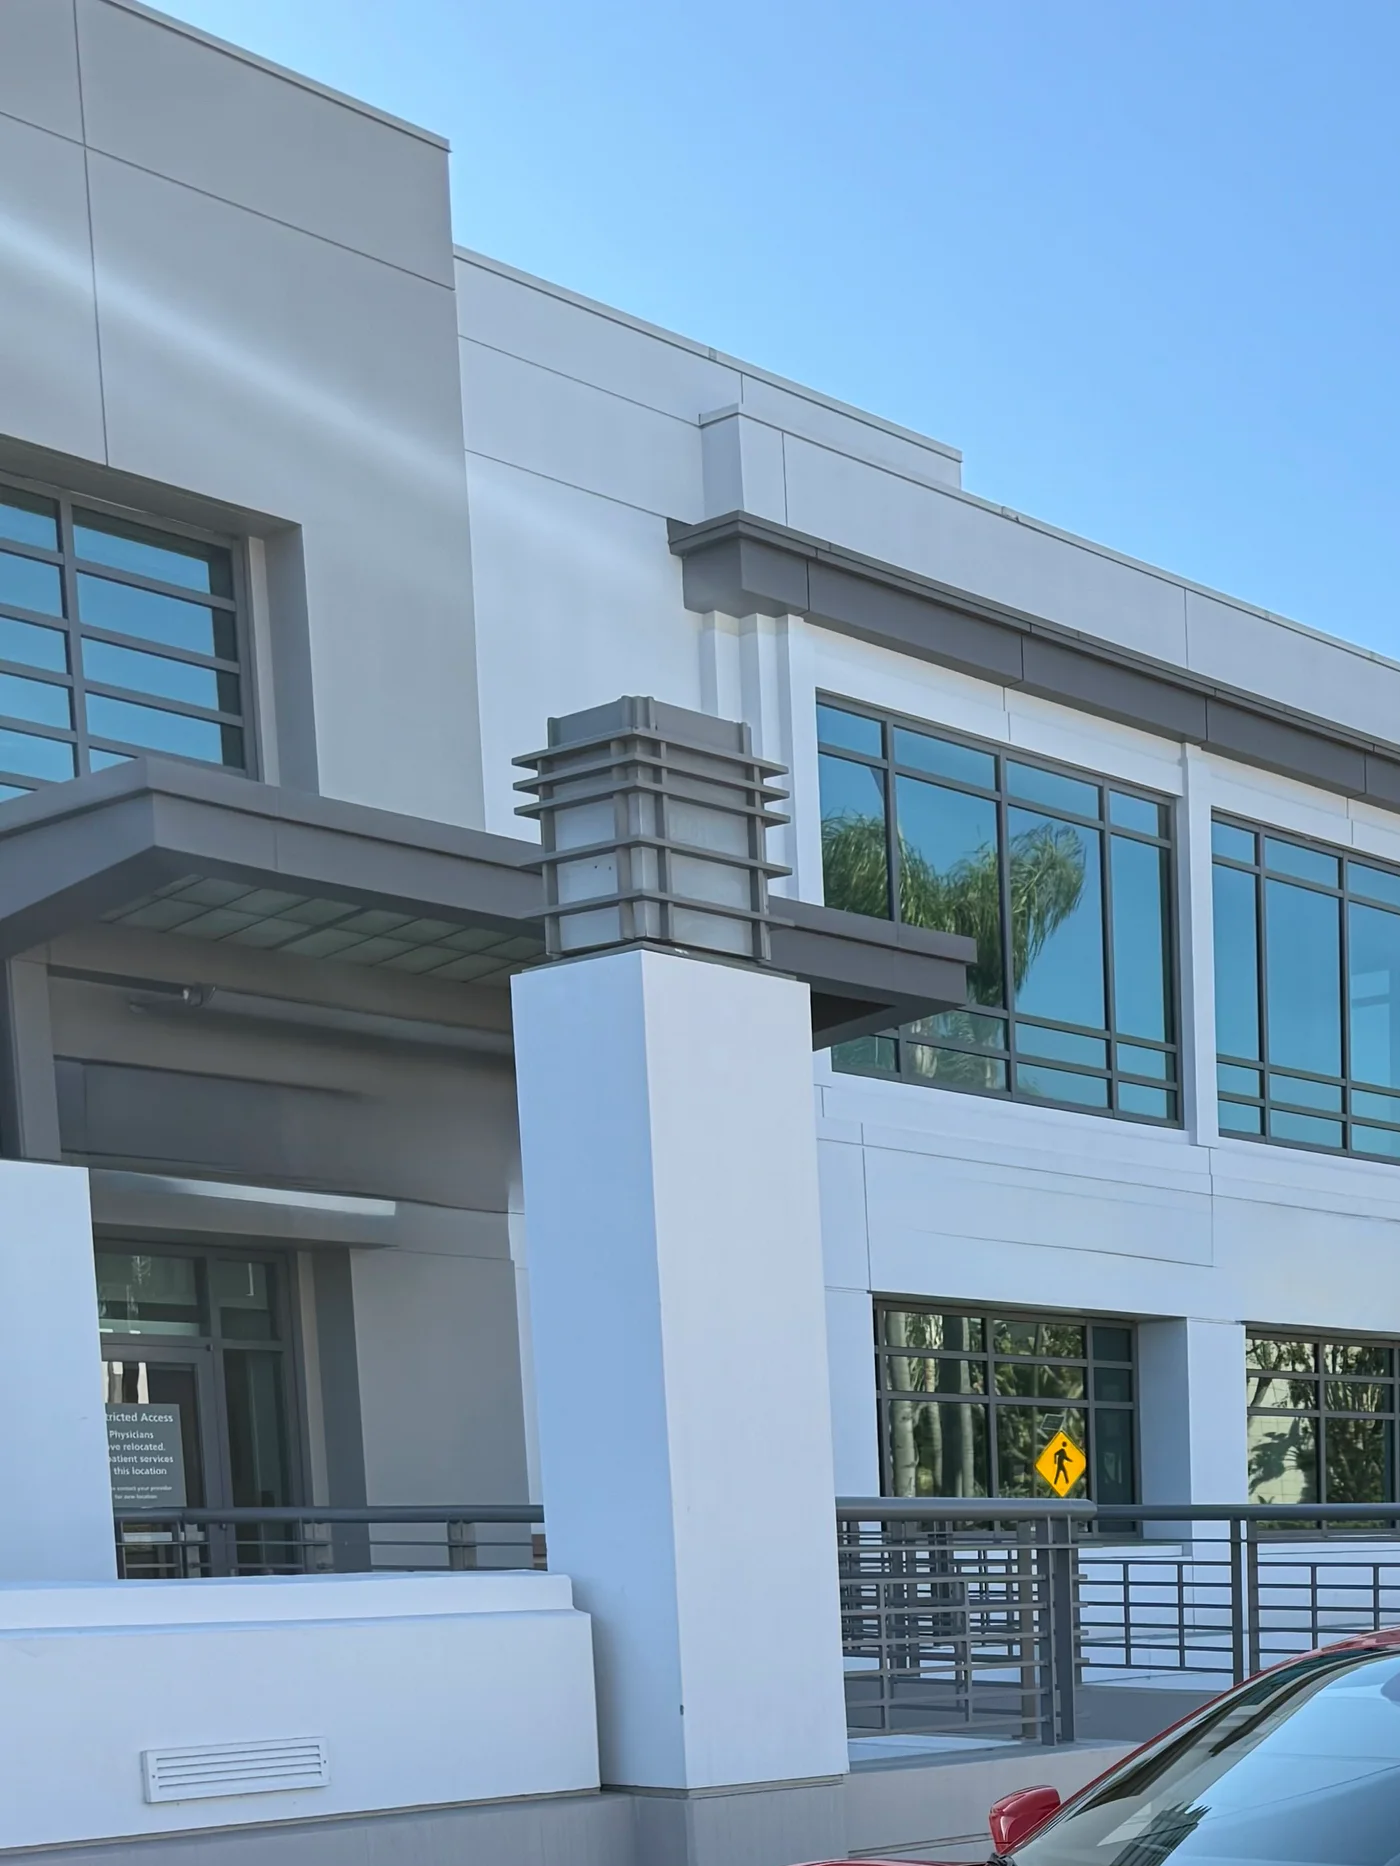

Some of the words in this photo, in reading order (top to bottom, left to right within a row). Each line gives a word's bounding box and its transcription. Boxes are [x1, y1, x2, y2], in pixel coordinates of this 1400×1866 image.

[106, 1412, 138, 1422] tricted
[140, 1413, 174, 1423] Access
[109, 1430, 154, 1441] Physicians
[123, 1442, 166, 1451] relocated.
[139, 1455, 174, 1463] services
[113, 1466, 130, 1475] this
[132, 1466, 167, 1475] location
